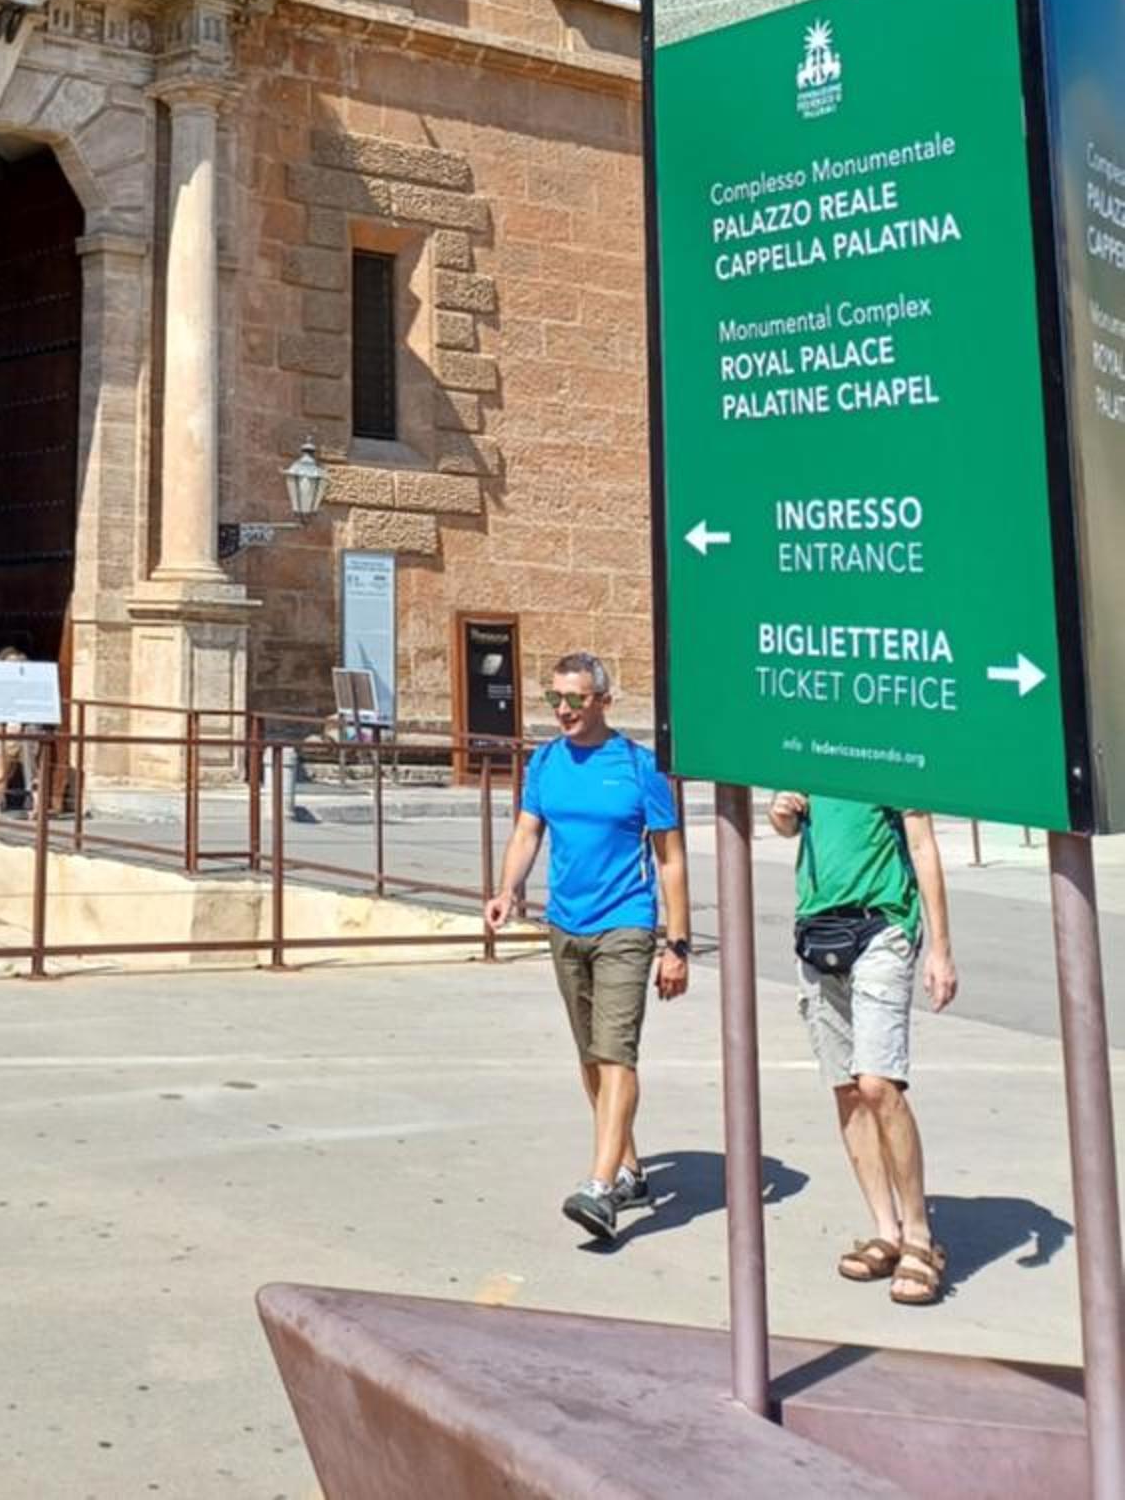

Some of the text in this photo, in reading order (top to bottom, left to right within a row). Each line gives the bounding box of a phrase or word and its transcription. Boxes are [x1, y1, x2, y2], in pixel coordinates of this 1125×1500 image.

[710, 133, 956, 205] Complesso Monumentale
[712, 181, 899, 243] PALAZZO REALE
[715, 212, 962, 281] CAPPELLA PALATINA
[719, 294, 932, 342] Monumental Complex
[720, 335, 895, 381] ROYAL PALACE
[722, 375, 940, 420] PALATINE CHAPEL
[776, 495, 923, 531] INGRESSO
[779, 541, 924, 573] ENTRANCE
[759, 622, 954, 663] BIGLIETTERIA
[756, 666, 957, 711] TICKET OFFICE
